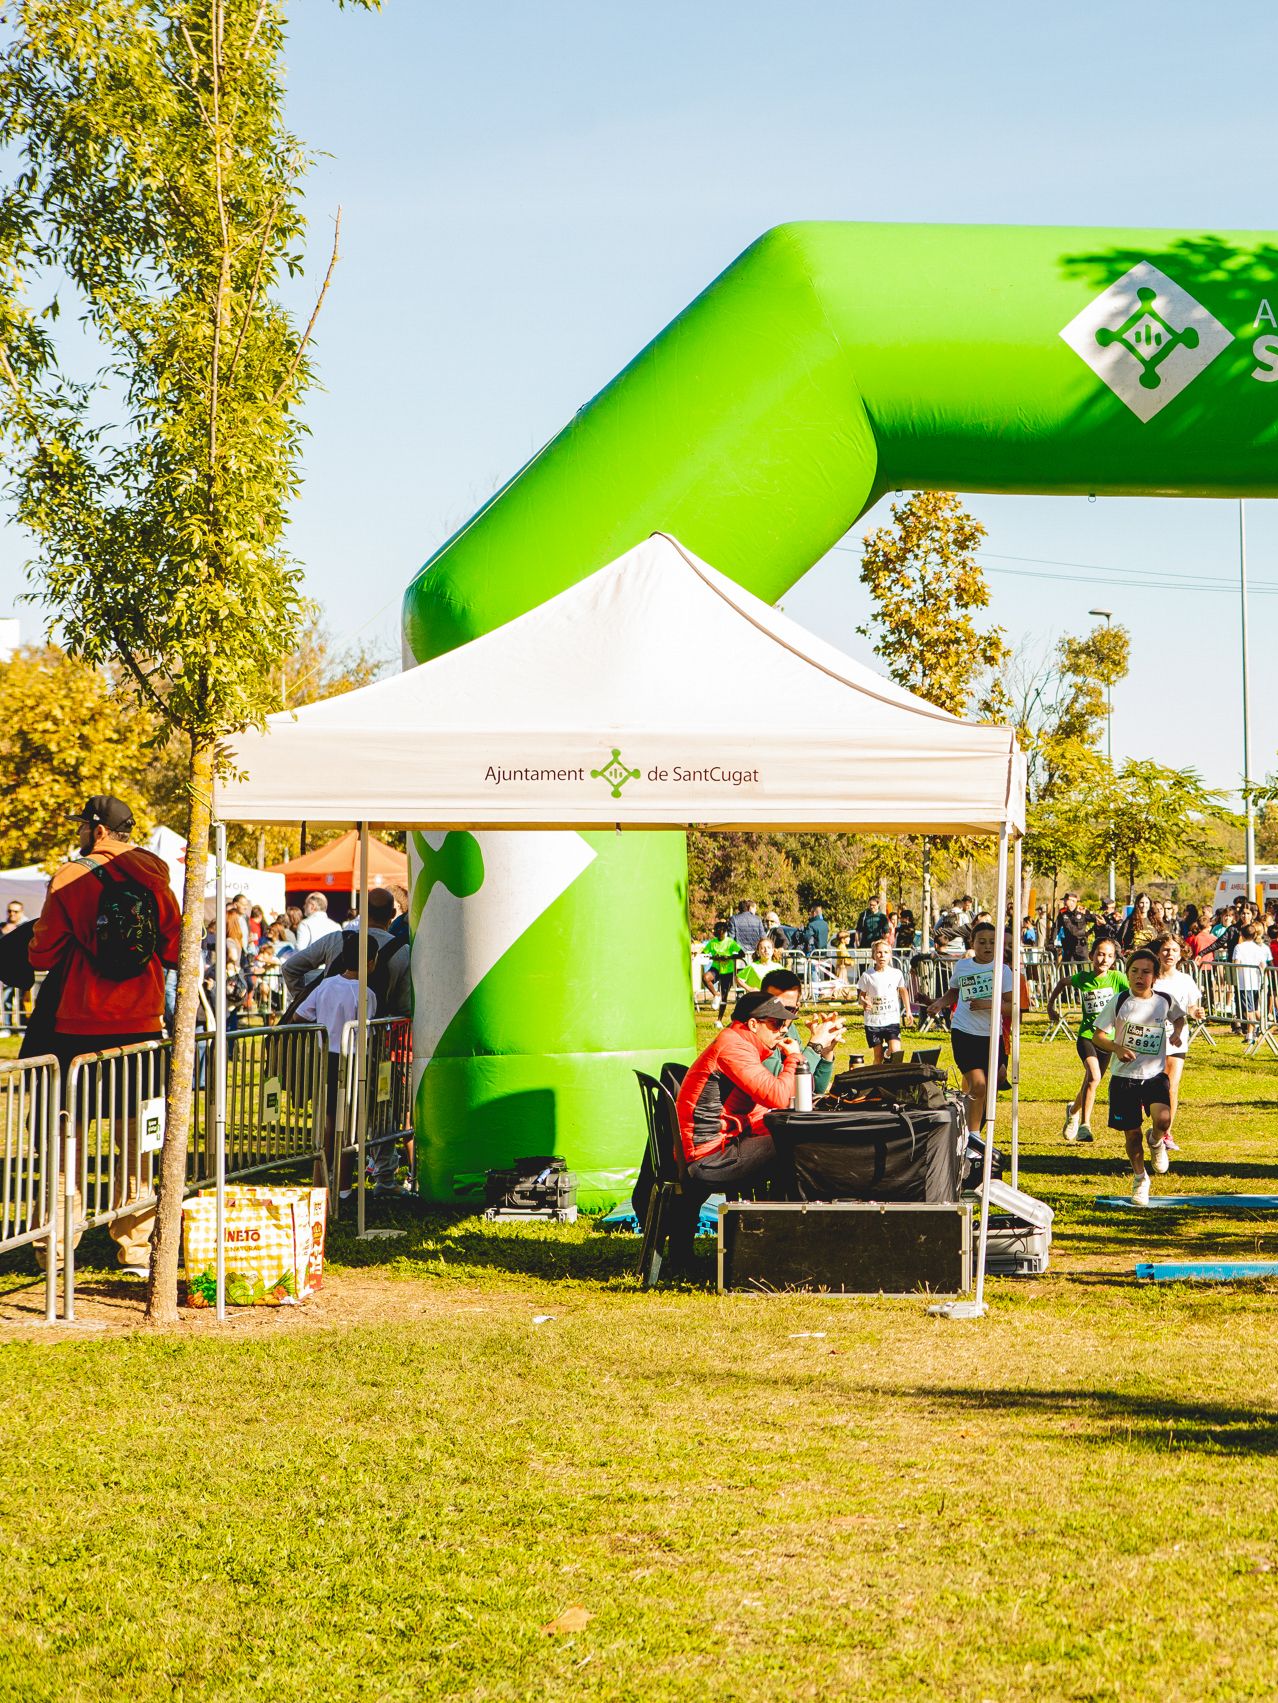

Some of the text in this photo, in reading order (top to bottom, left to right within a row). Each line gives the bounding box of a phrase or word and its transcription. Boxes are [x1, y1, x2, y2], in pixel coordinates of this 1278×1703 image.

[484, 765, 759, 786] Ajuntament de SantCugat
